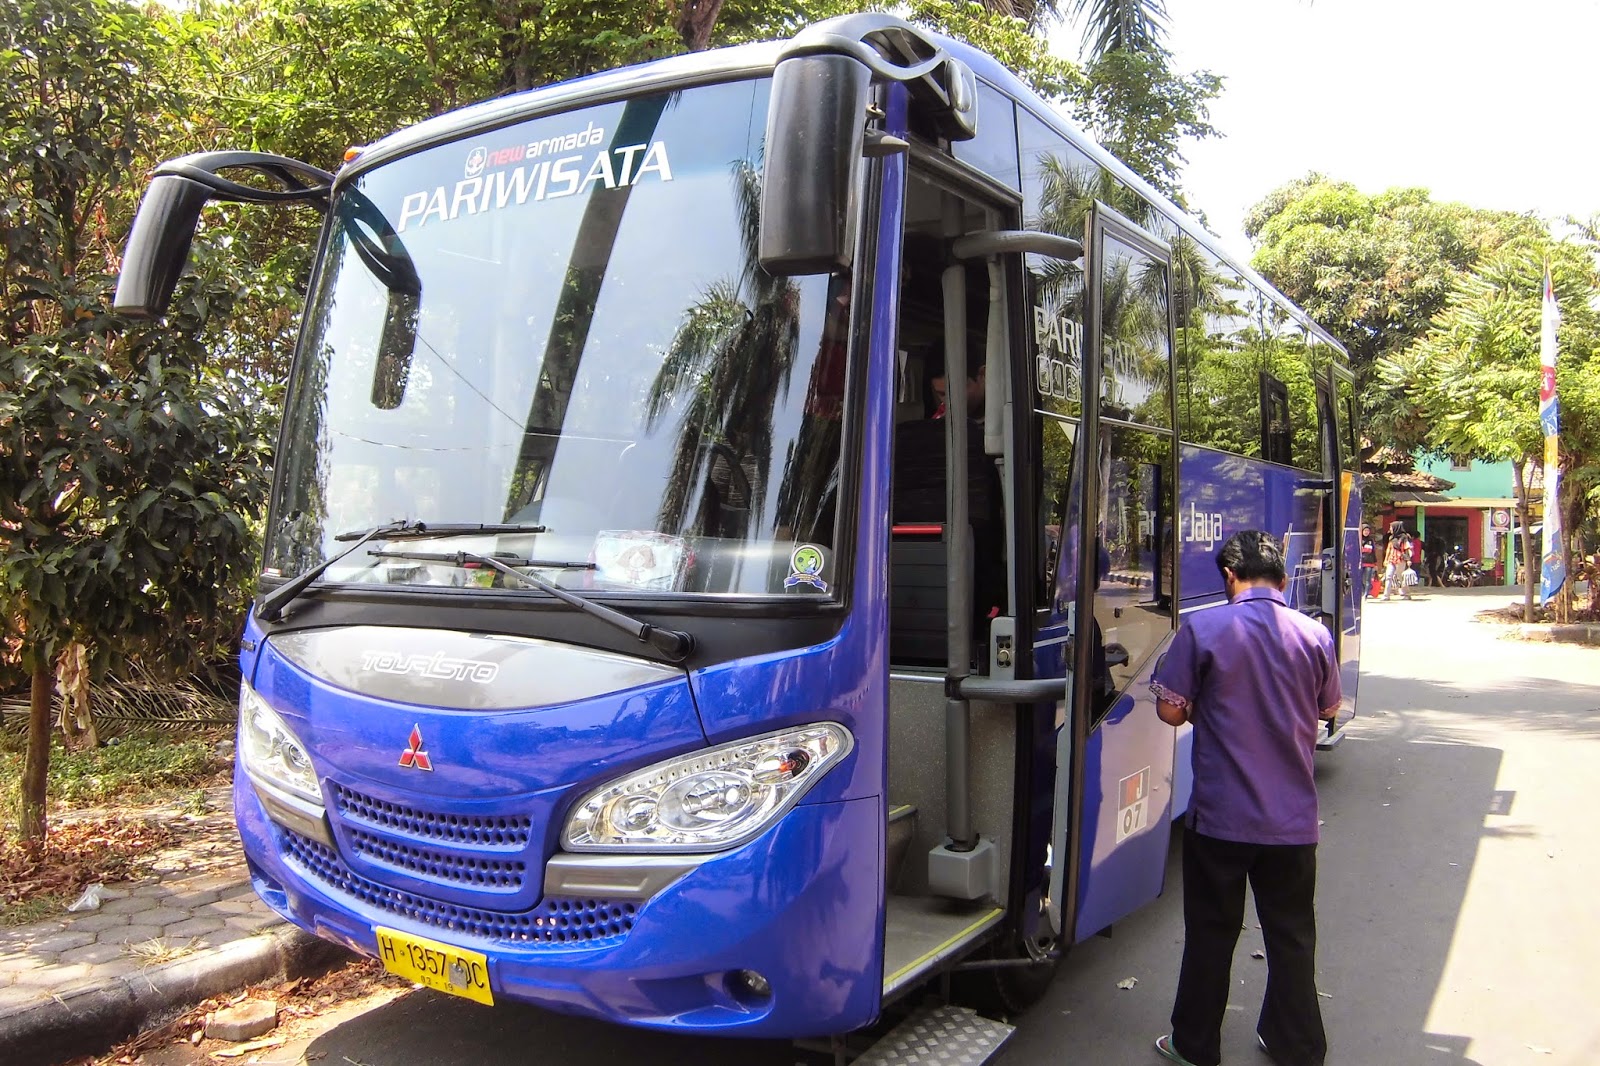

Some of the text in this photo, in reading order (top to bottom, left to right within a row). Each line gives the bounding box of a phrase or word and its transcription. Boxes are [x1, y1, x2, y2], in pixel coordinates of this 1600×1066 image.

[486, 121, 604, 168] new armada
[397, 141, 673, 232] PARIWISATA
[1186, 502, 1222, 552] Jaya
[1123, 803, 1142, 834] 07
[381, 936, 397, 962] H
[406, 943, 447, 977] 1357
